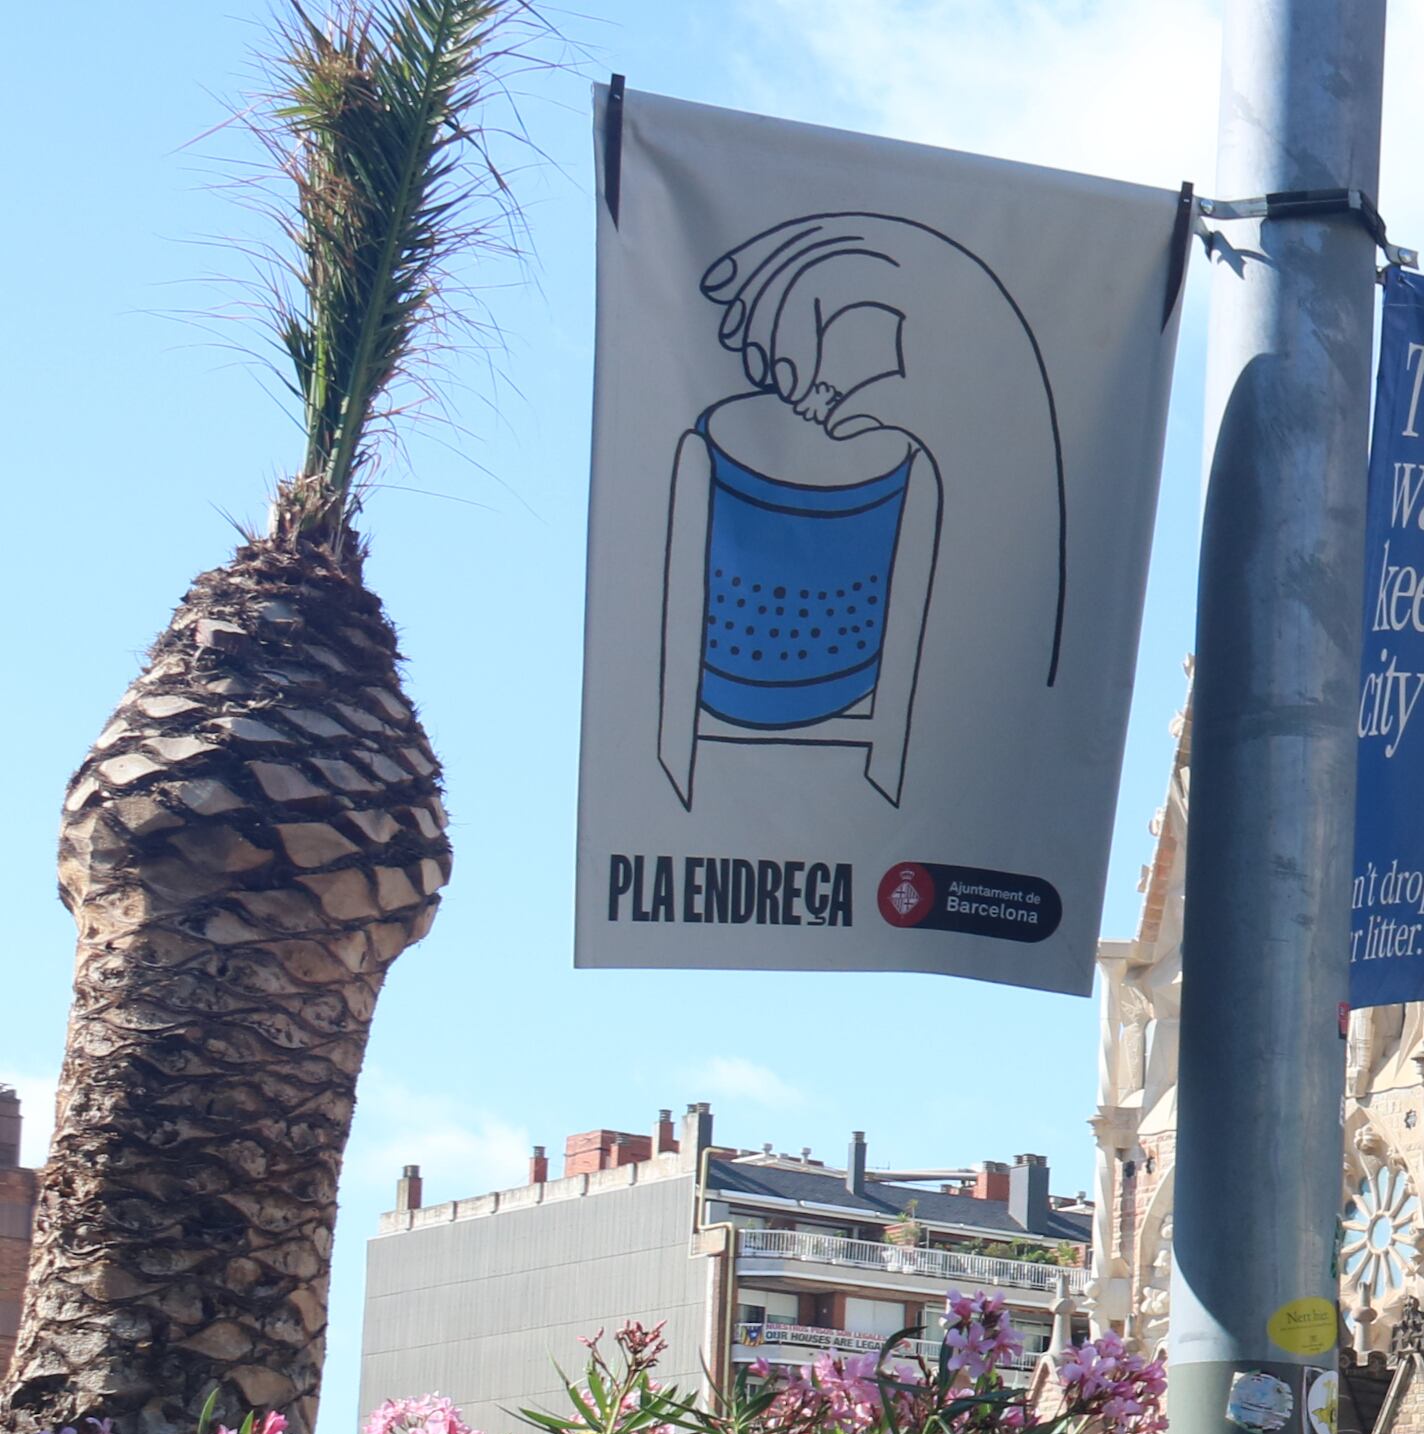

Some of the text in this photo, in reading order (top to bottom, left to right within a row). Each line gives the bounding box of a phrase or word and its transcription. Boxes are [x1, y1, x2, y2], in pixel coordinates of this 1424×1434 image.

[608, 854, 853, 927] PLA ENDREÇA
[949, 881, 1041, 904] Ajuntament de
[946, 896, 1038, 924] Barcelona
[1363, 915, 1422, 960] litter.
[766, 1331, 883, 1350] OUR HOUSES ARE LEGA
